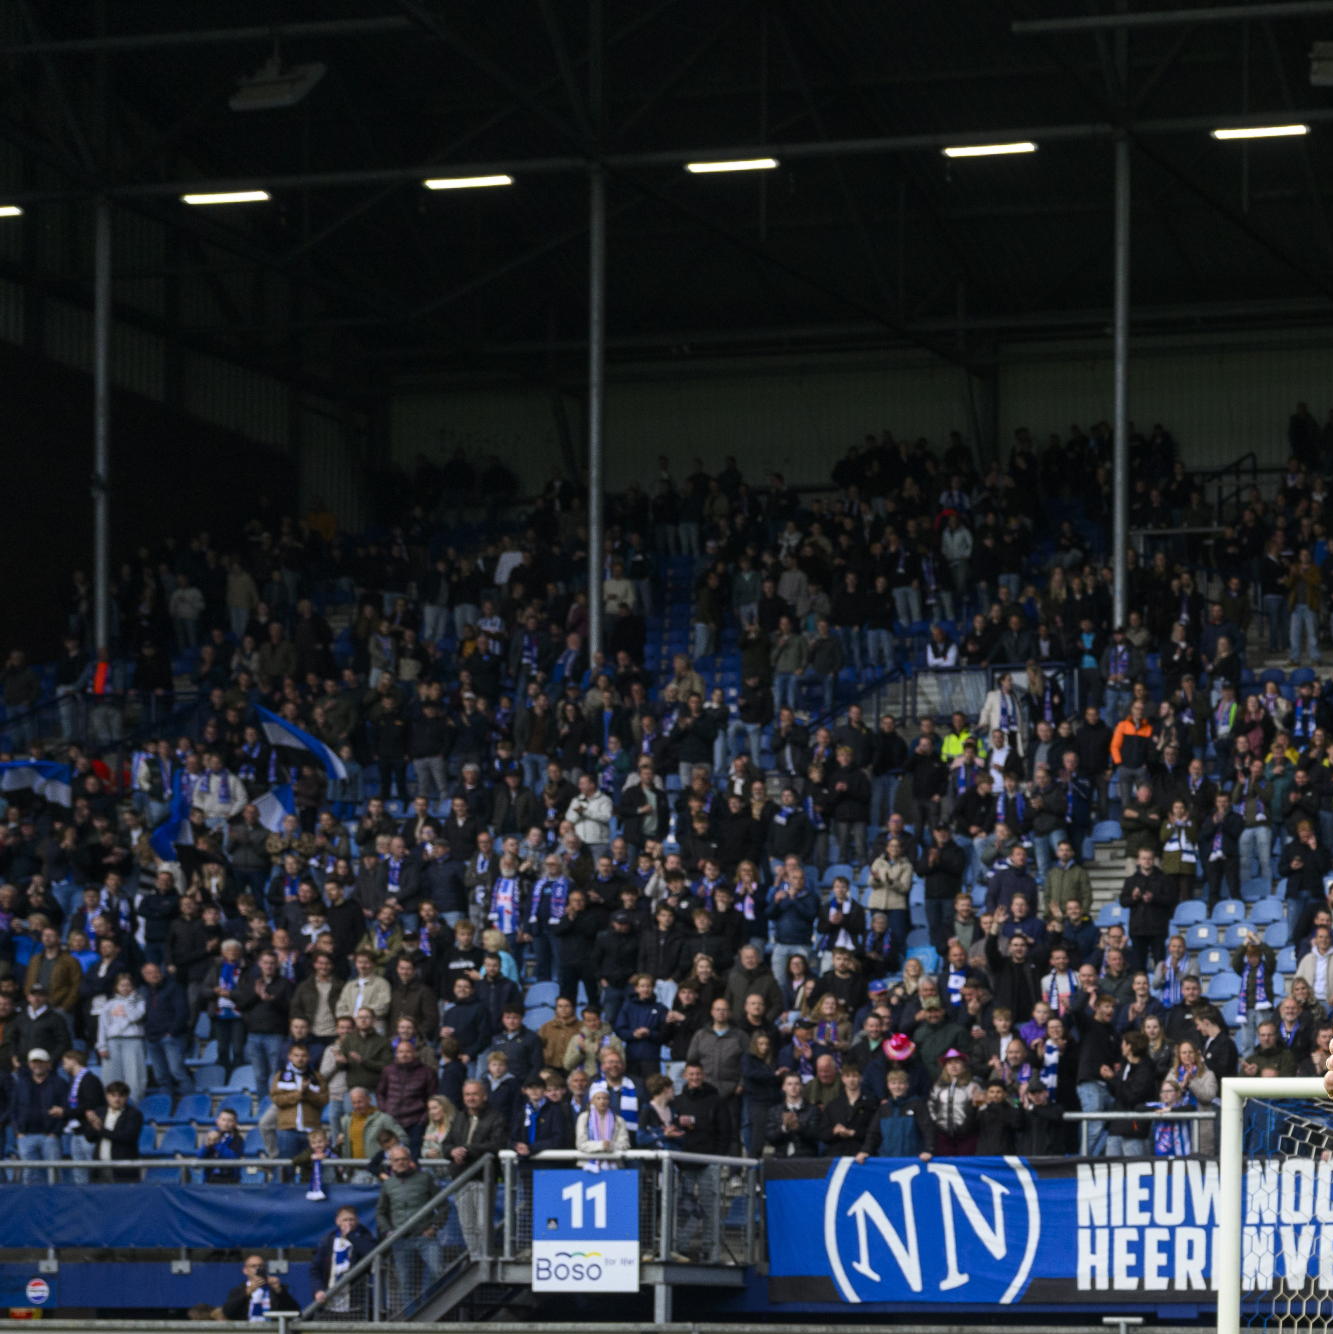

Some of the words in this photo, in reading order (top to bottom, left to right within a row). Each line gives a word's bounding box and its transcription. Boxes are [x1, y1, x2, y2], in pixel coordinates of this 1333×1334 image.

[562, 1181, 607, 1229] 11
[1076, 1160, 1221, 1227] NIEUW
[847, 1163, 1010, 1292] NN
